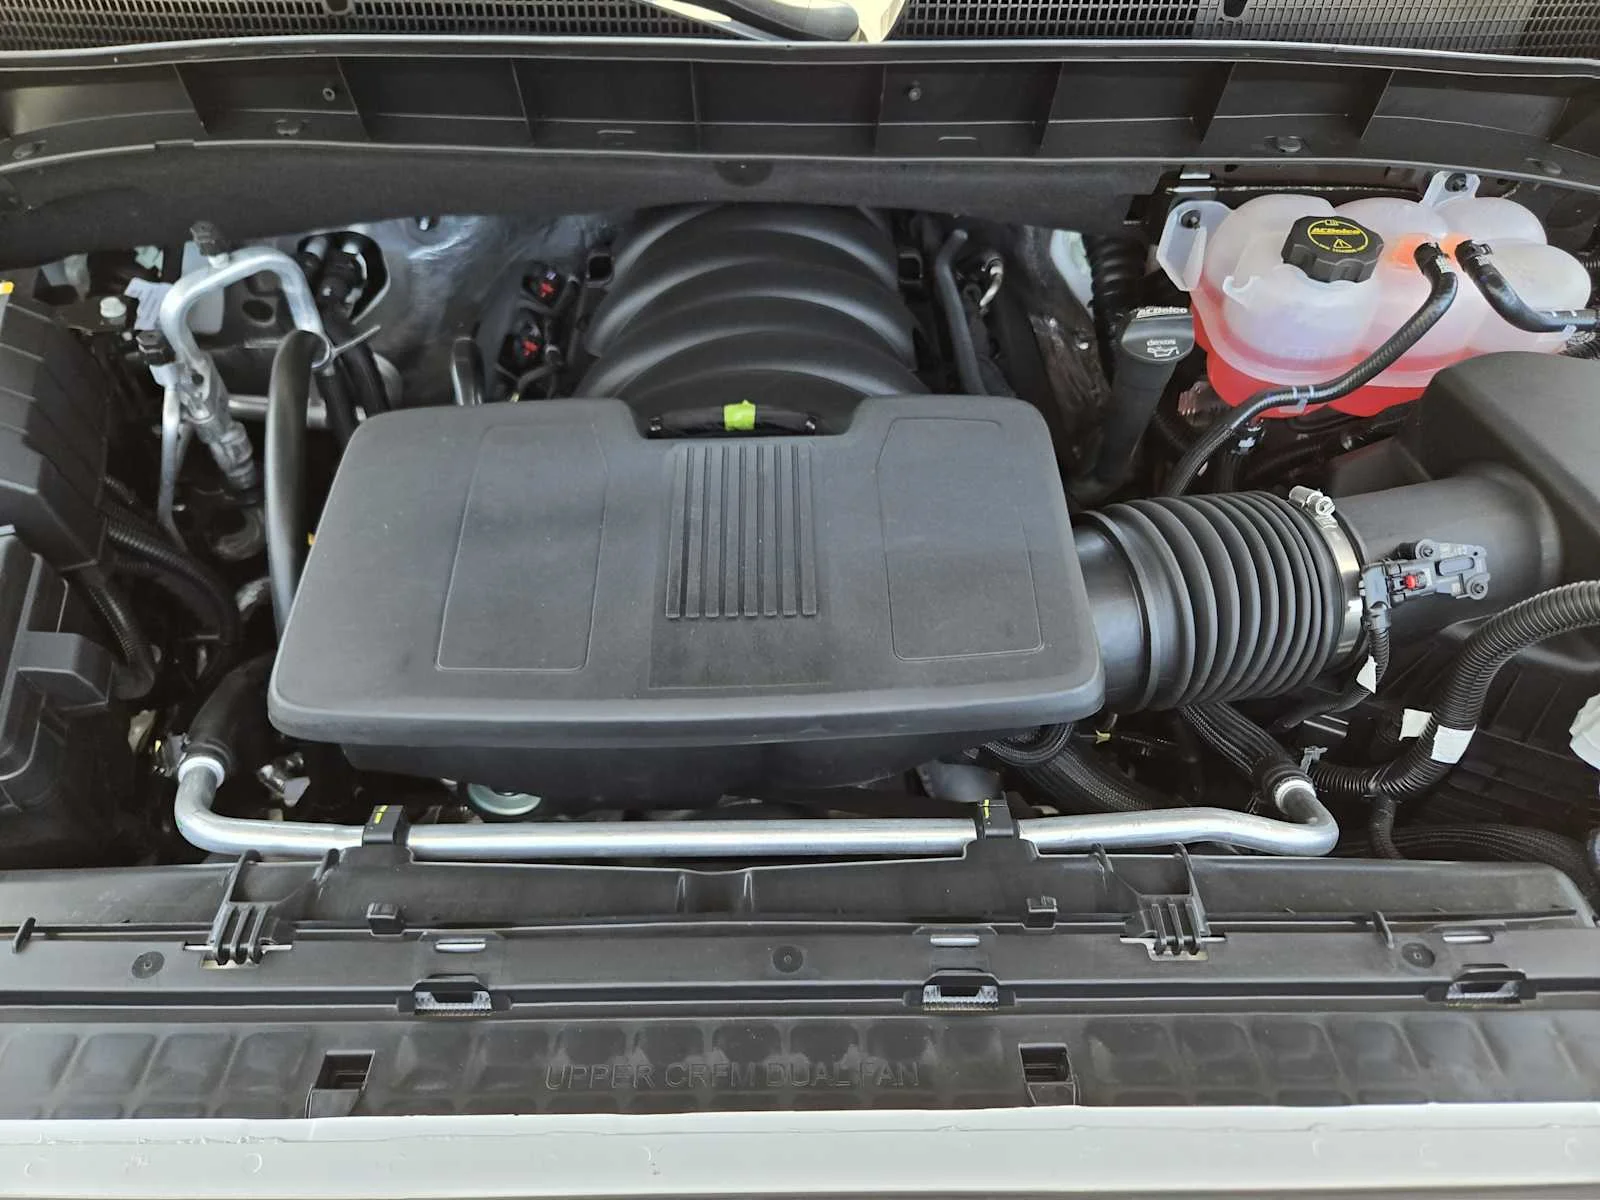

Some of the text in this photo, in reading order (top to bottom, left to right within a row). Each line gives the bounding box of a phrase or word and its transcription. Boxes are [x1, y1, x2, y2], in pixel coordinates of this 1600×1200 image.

[545, 1062, 919, 1090] UPPER CRFM DUAL FAN
